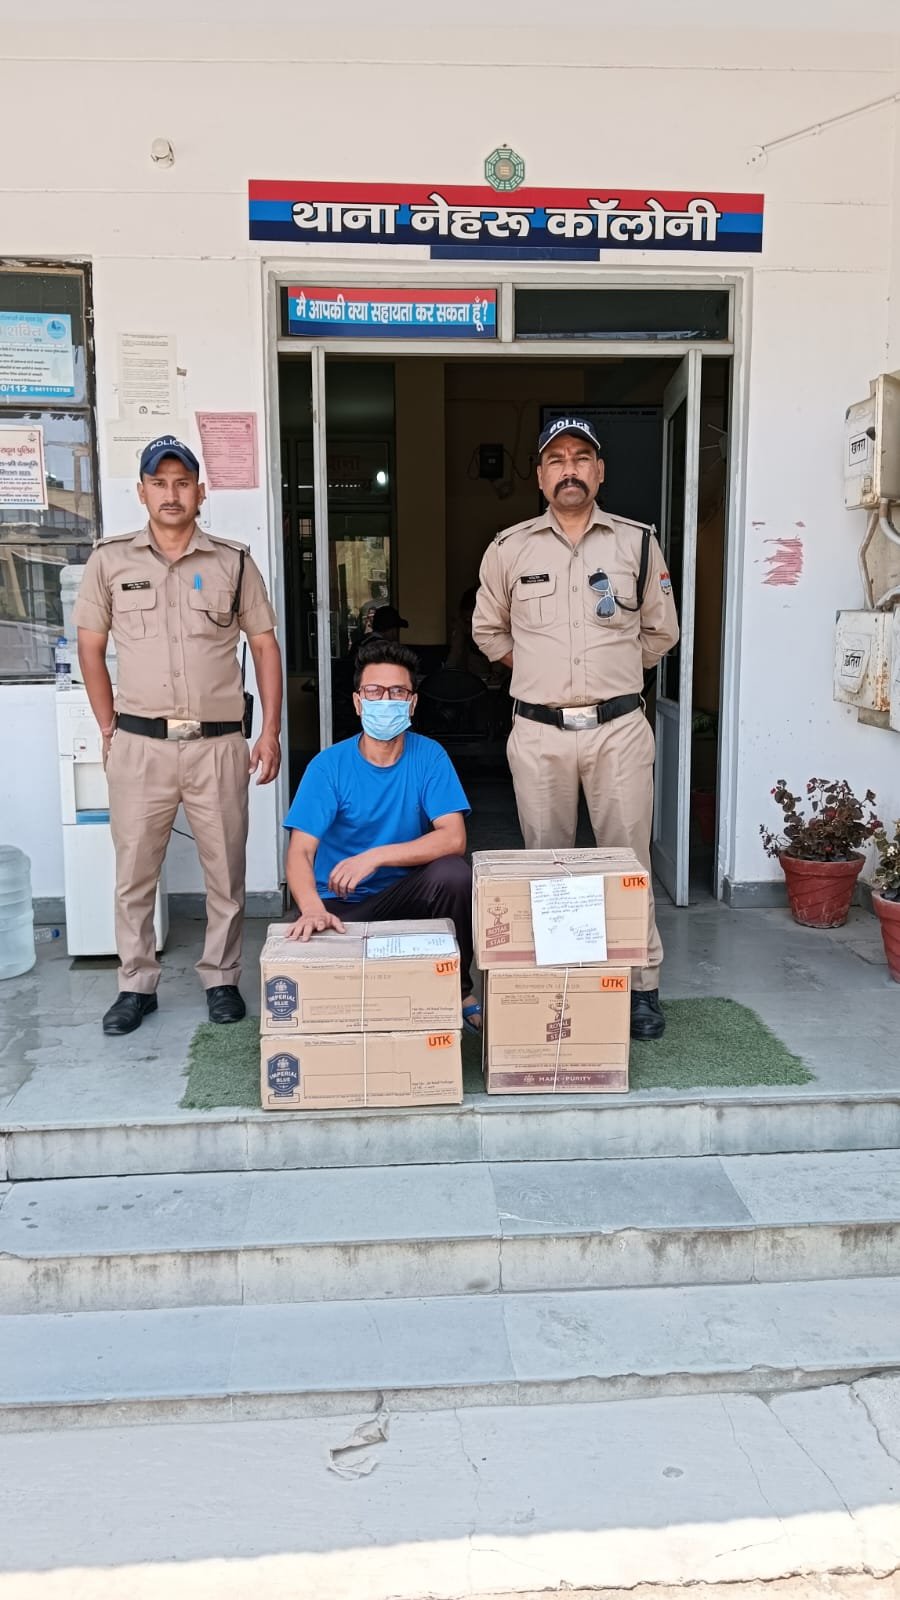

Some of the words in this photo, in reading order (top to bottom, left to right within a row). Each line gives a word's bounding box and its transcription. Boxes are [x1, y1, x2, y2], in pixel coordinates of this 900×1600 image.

[292, 201, 400, 234] थाना
[409, 192, 535, 239] नेहरू
[545, 198, 721, 241] कॉलोनी
[309, 293, 346, 320] आपकी
[347, 302, 369, 321] क्या
[370, 302, 413, 324] सहायता
[414, 303, 435, 322] कर
[436, 303, 471, 322] सकता
[550, 418, 591, 434] POLICE
[150, 438, 187, 452] POLICE
[623, 876, 646, 889] UTK
[602, 978, 624, 989] UTK
[268, 994, 296, 1003] IMPERIAL
[428, 1034, 452, 1047] UTK
[270, 1071, 297, 1080] IMPERIAL
